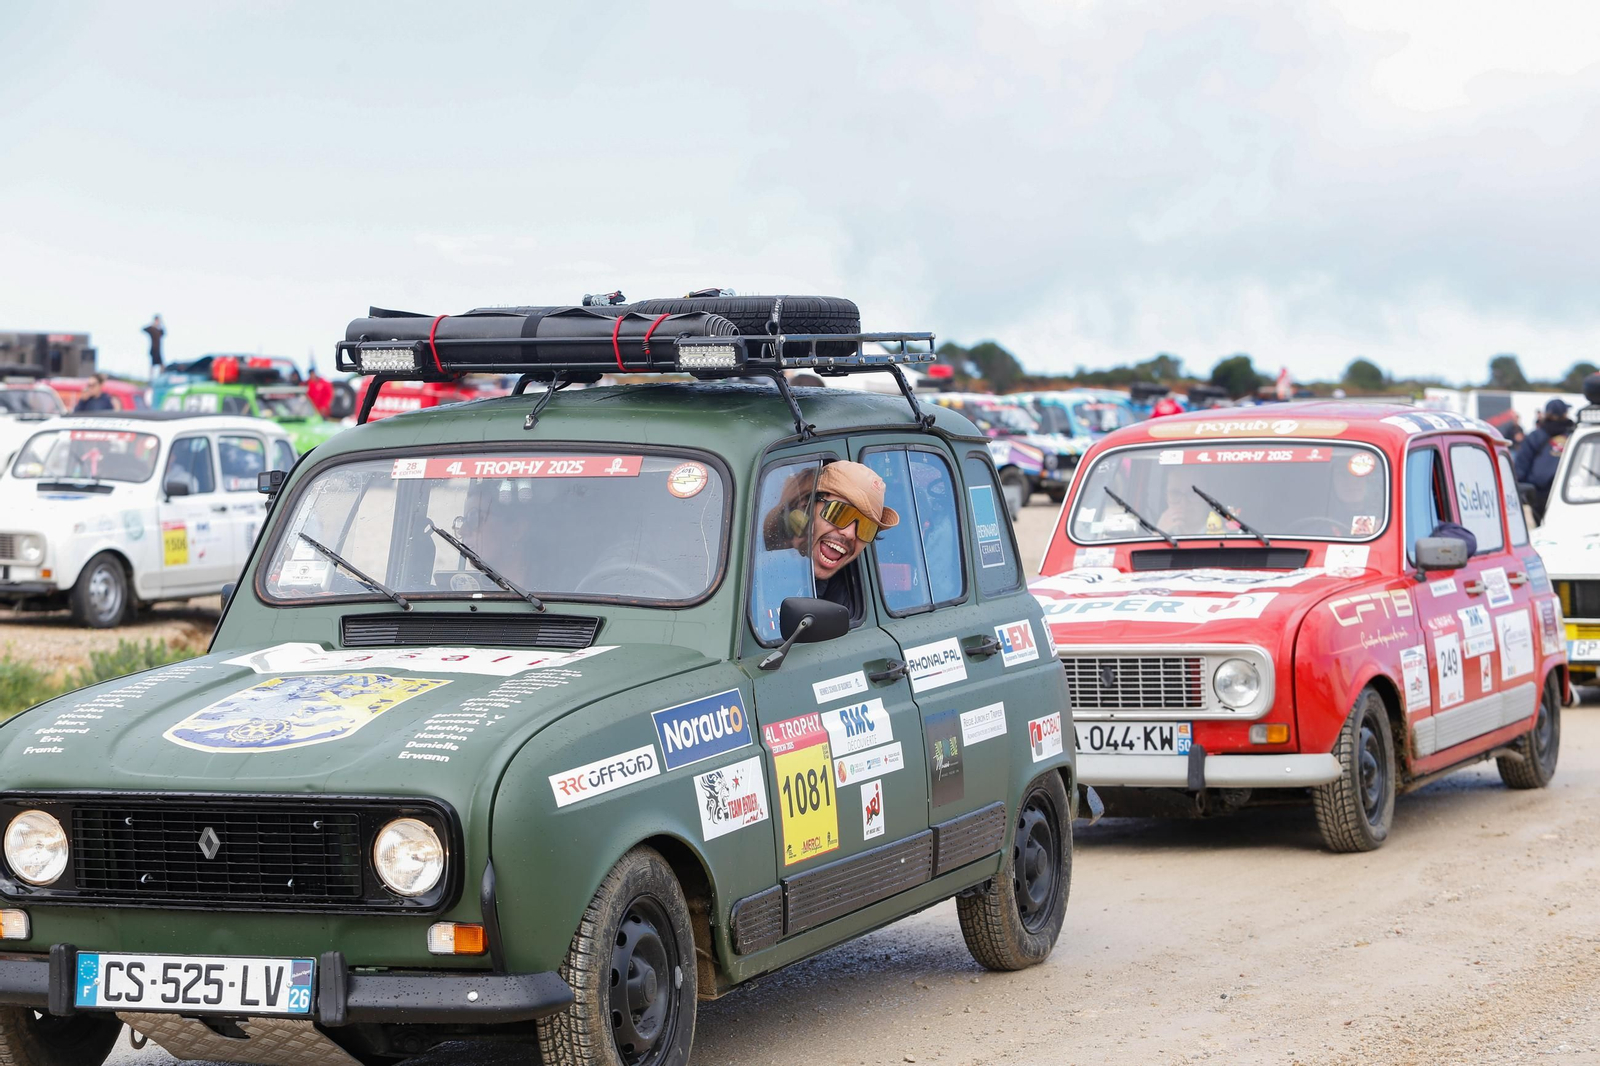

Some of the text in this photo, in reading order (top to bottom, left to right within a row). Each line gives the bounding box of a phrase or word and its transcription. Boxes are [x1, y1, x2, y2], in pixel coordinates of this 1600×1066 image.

[1194, 420, 1268, 435] popub
[1196, 452, 1212, 462] 4L
[1216, 450, 1266, 462] TROPHY
[1267, 450, 1294, 461] 2025
[445, 460, 586, 476] 4L TROPHY 2025
[978, 523, 998, 538] BERNARD
[982, 543, 1000, 554] CERAMICS
[1328, 588, 1414, 627] CFTB
[909, 648, 961, 673] RHONALPAL
[1440, 649, 1458, 678] 249
[425, 724, 475, 732] Mathys
[663, 704, 743, 754] Norauto
[765, 714, 820, 744] 4L TROPHY
[839, 704, 875, 738] RMC
[1042, 715, 1060, 736] COBALT
[405, 740, 459, 751] Danielle
[414, 732, 468, 741] Hadrien
[1178, 740, 1191, 752] 50
[23, 746, 65, 755] Frantz
[398, 751, 450, 762] Erwann
[557, 774, 588, 796] RRC
[783, 765, 830, 818] 1081
[728, 798, 743, 820] TEAM
[866, 783, 880, 826] NRJ
[83, 986, 91, 997] F
[104, 962, 284, 1006] CS-525-LV
[289, 988, 310, 1010] 26
